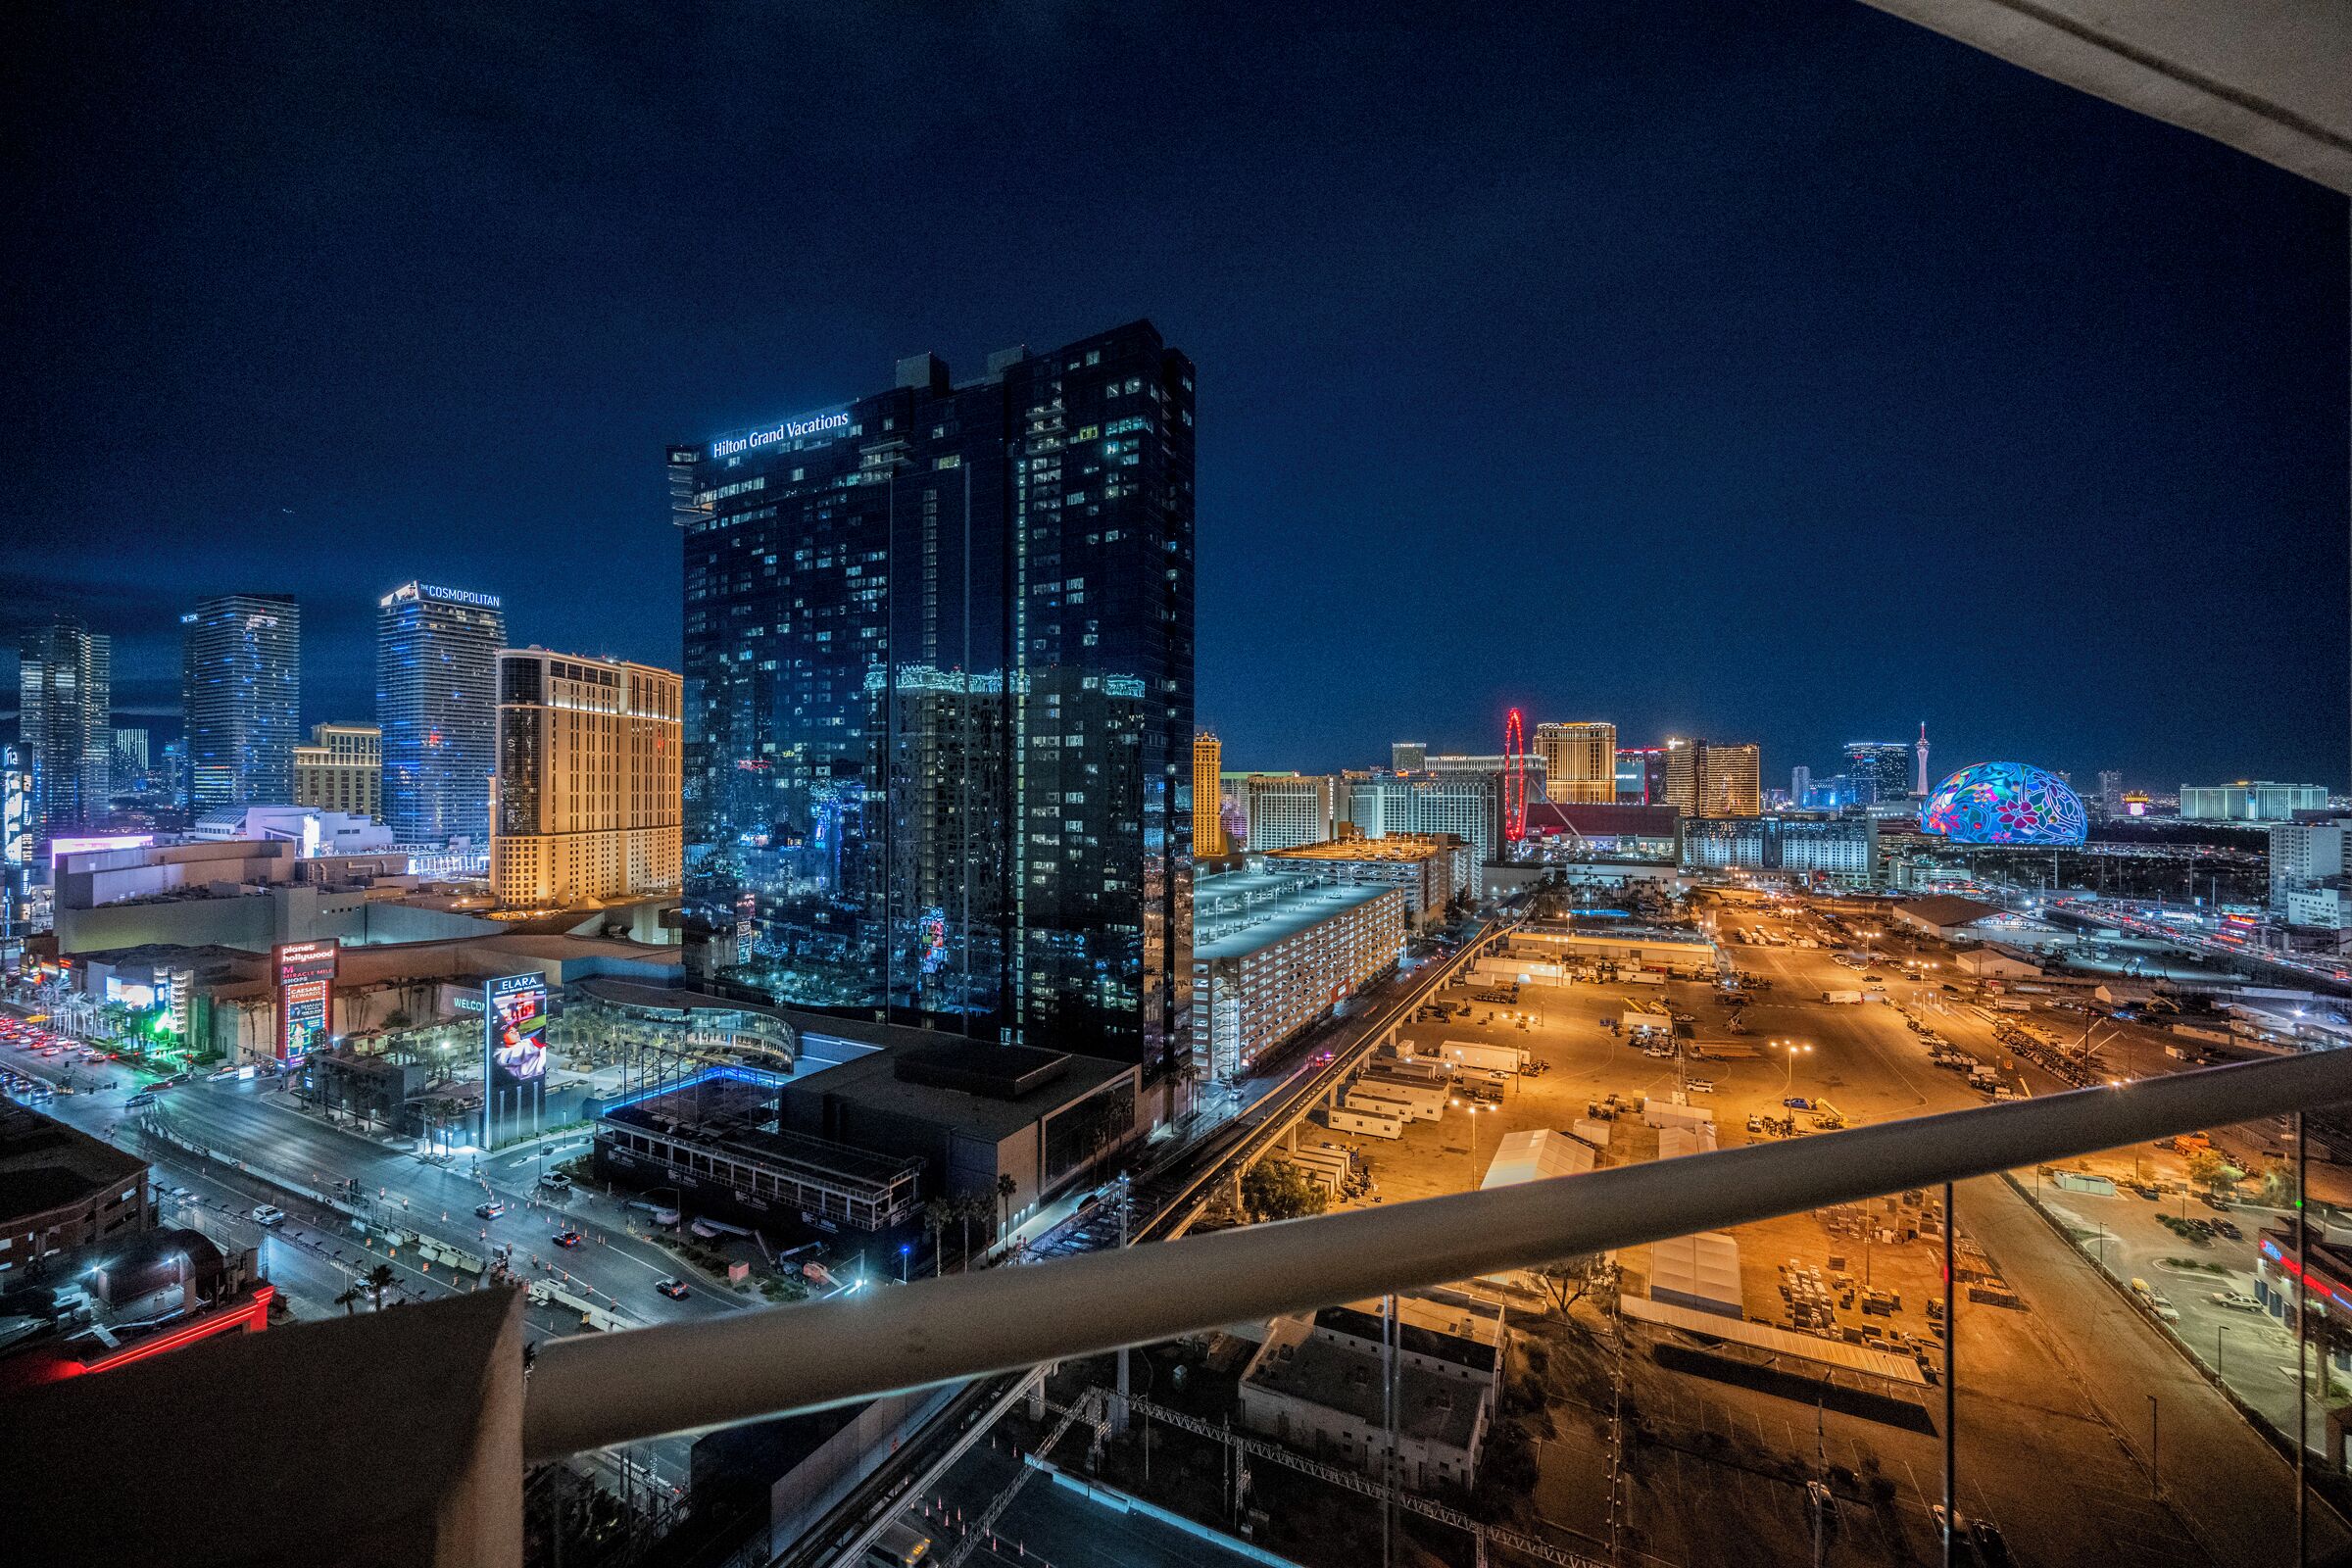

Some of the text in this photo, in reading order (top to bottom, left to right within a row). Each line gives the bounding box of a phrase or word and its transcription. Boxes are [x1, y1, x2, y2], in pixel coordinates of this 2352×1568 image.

[713, 412, 849, 458] Hilton Grand Vacations
[429, 585, 500, 607] COSMOPOLITAN
[282, 944, 316, 956] planet
[282, 949, 334, 961] hollywood
[282, 970, 315, 979] MIRACLE
[503, 976, 537, 990] ELARA
[291, 985, 321, 995] CAESARS
